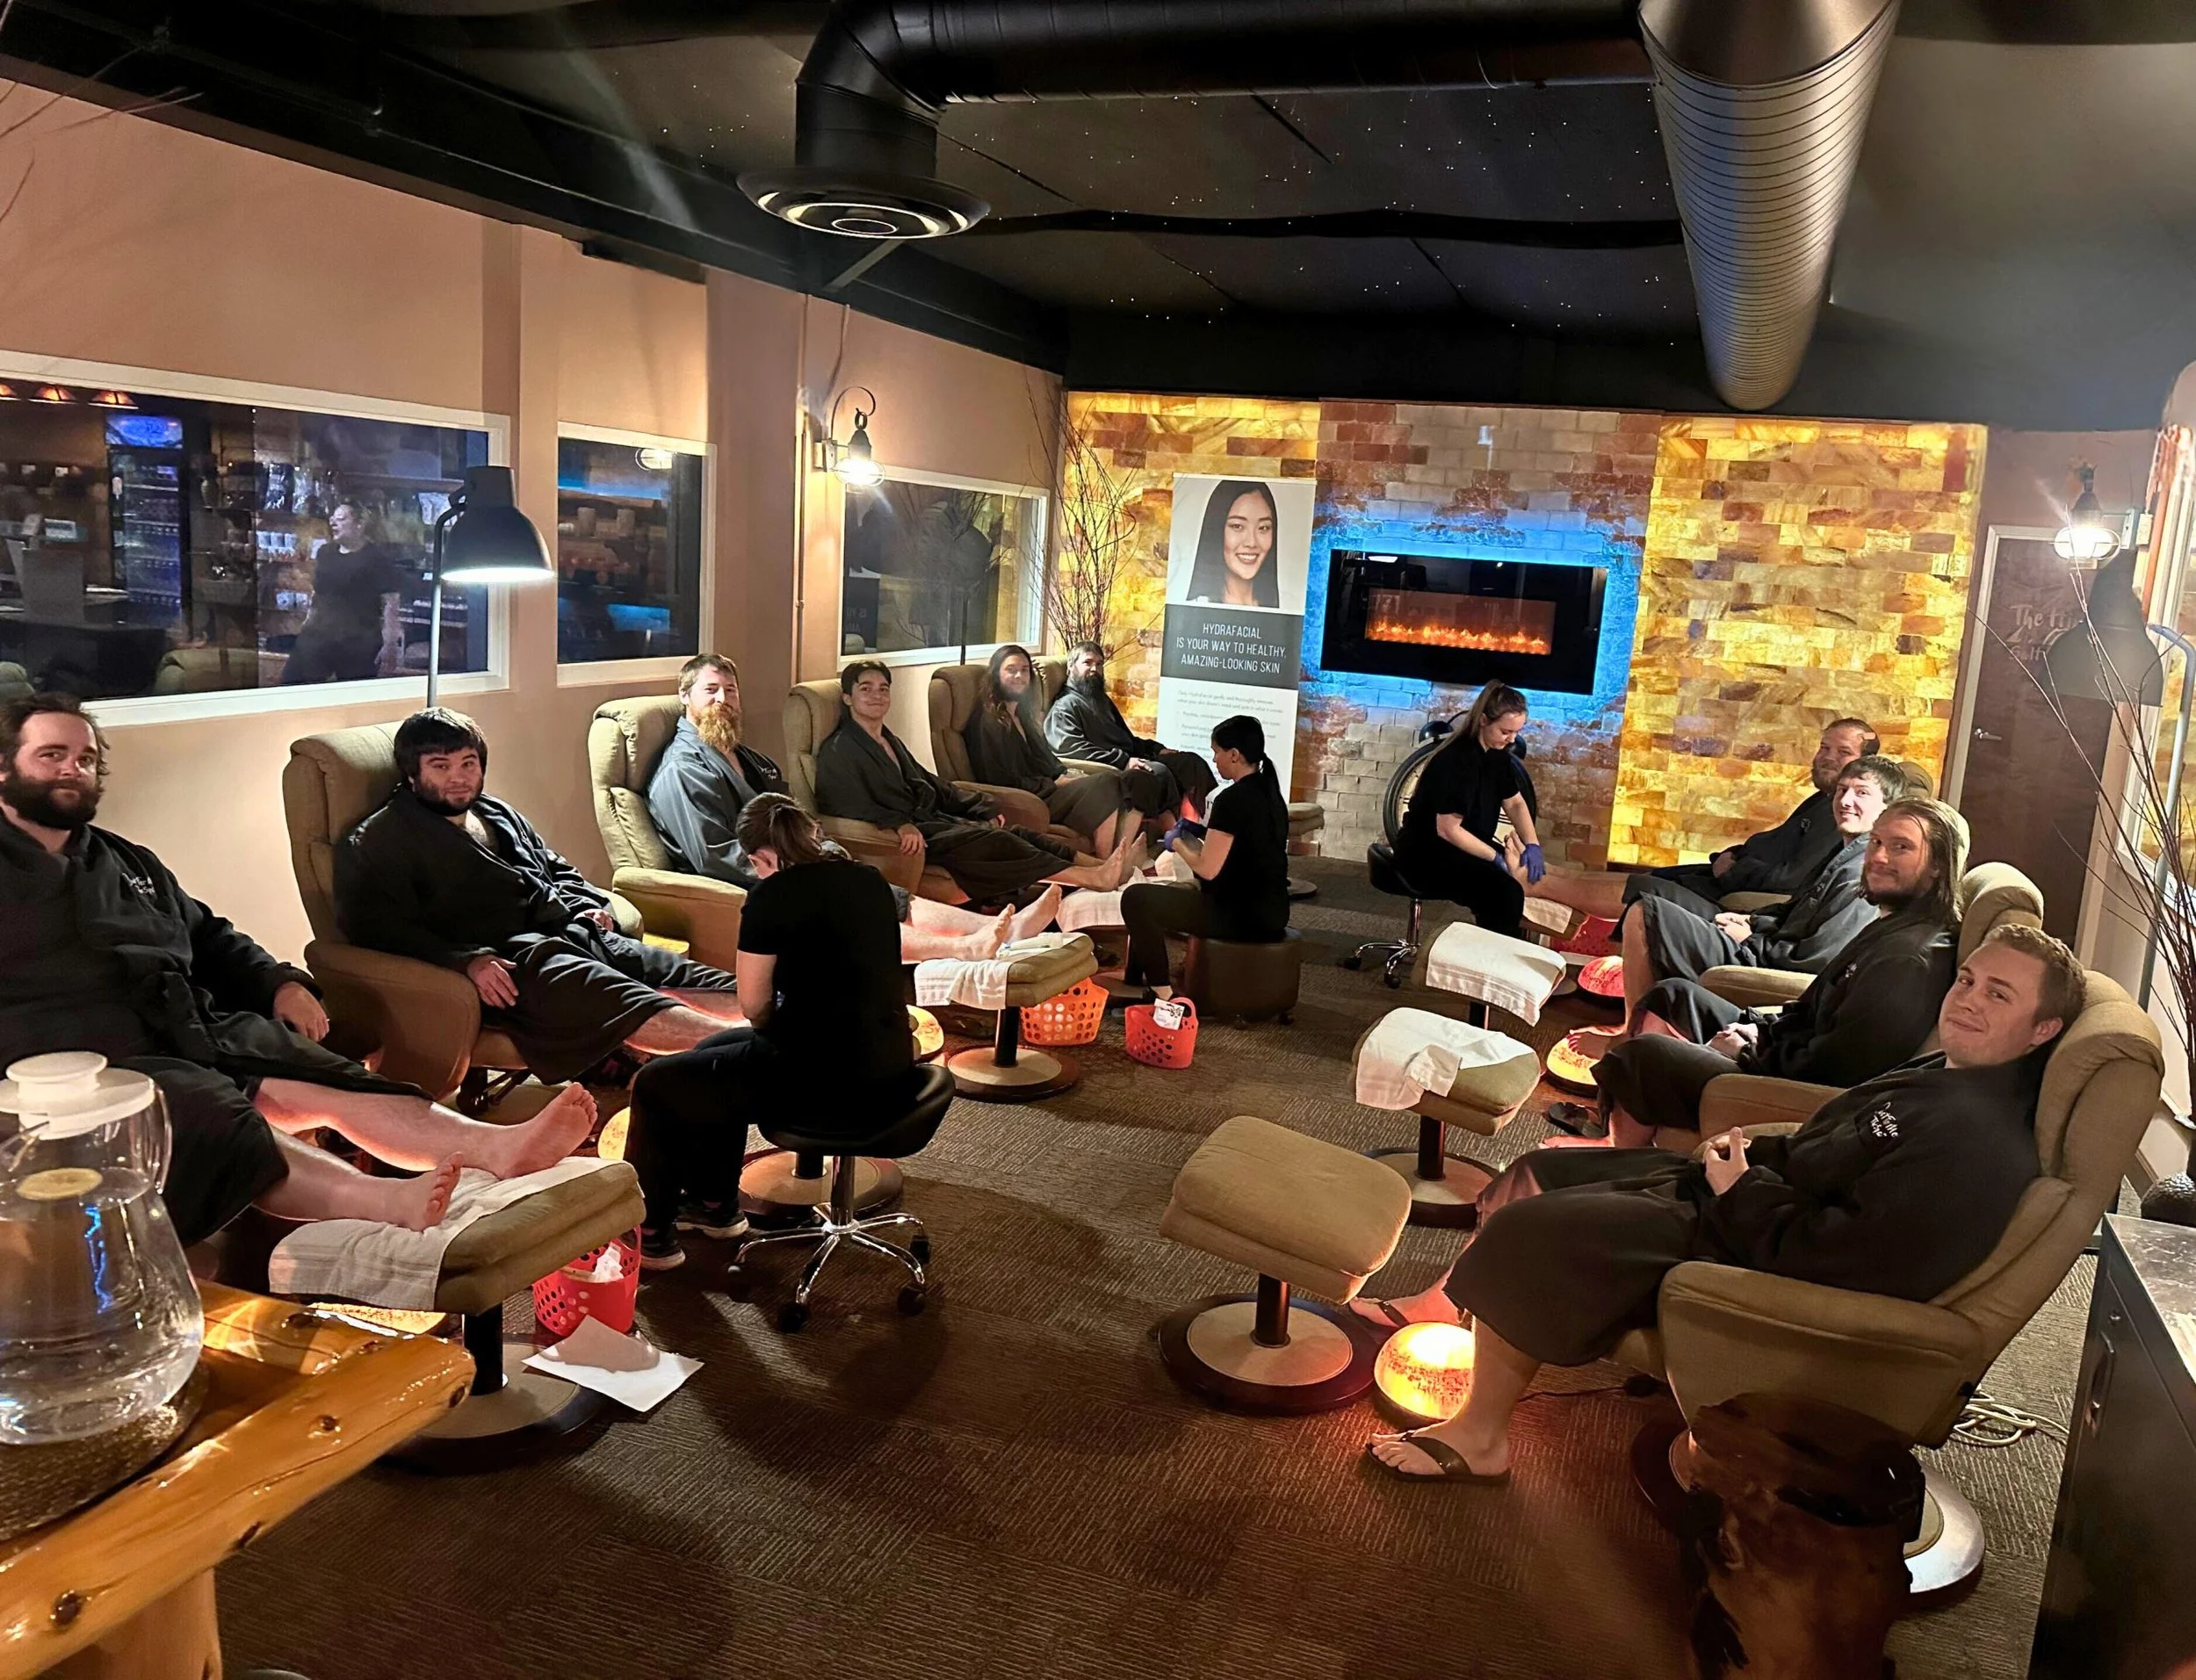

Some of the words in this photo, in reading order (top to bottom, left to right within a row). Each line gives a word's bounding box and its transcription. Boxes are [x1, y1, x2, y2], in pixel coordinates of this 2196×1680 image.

[2009, 603, 2044, 630] The
[1203, 623, 1261, 639] HYDRAFACIAL
[1176, 637, 1184, 648] IS
[1187, 638, 1209, 651] YOUR
[1211, 640, 1231, 653] WAY
[1234, 642, 1245, 654] TO
[1181, 653, 1258, 672] AMAZING-LOOKING
[1260, 660, 1281, 674] SKIN
